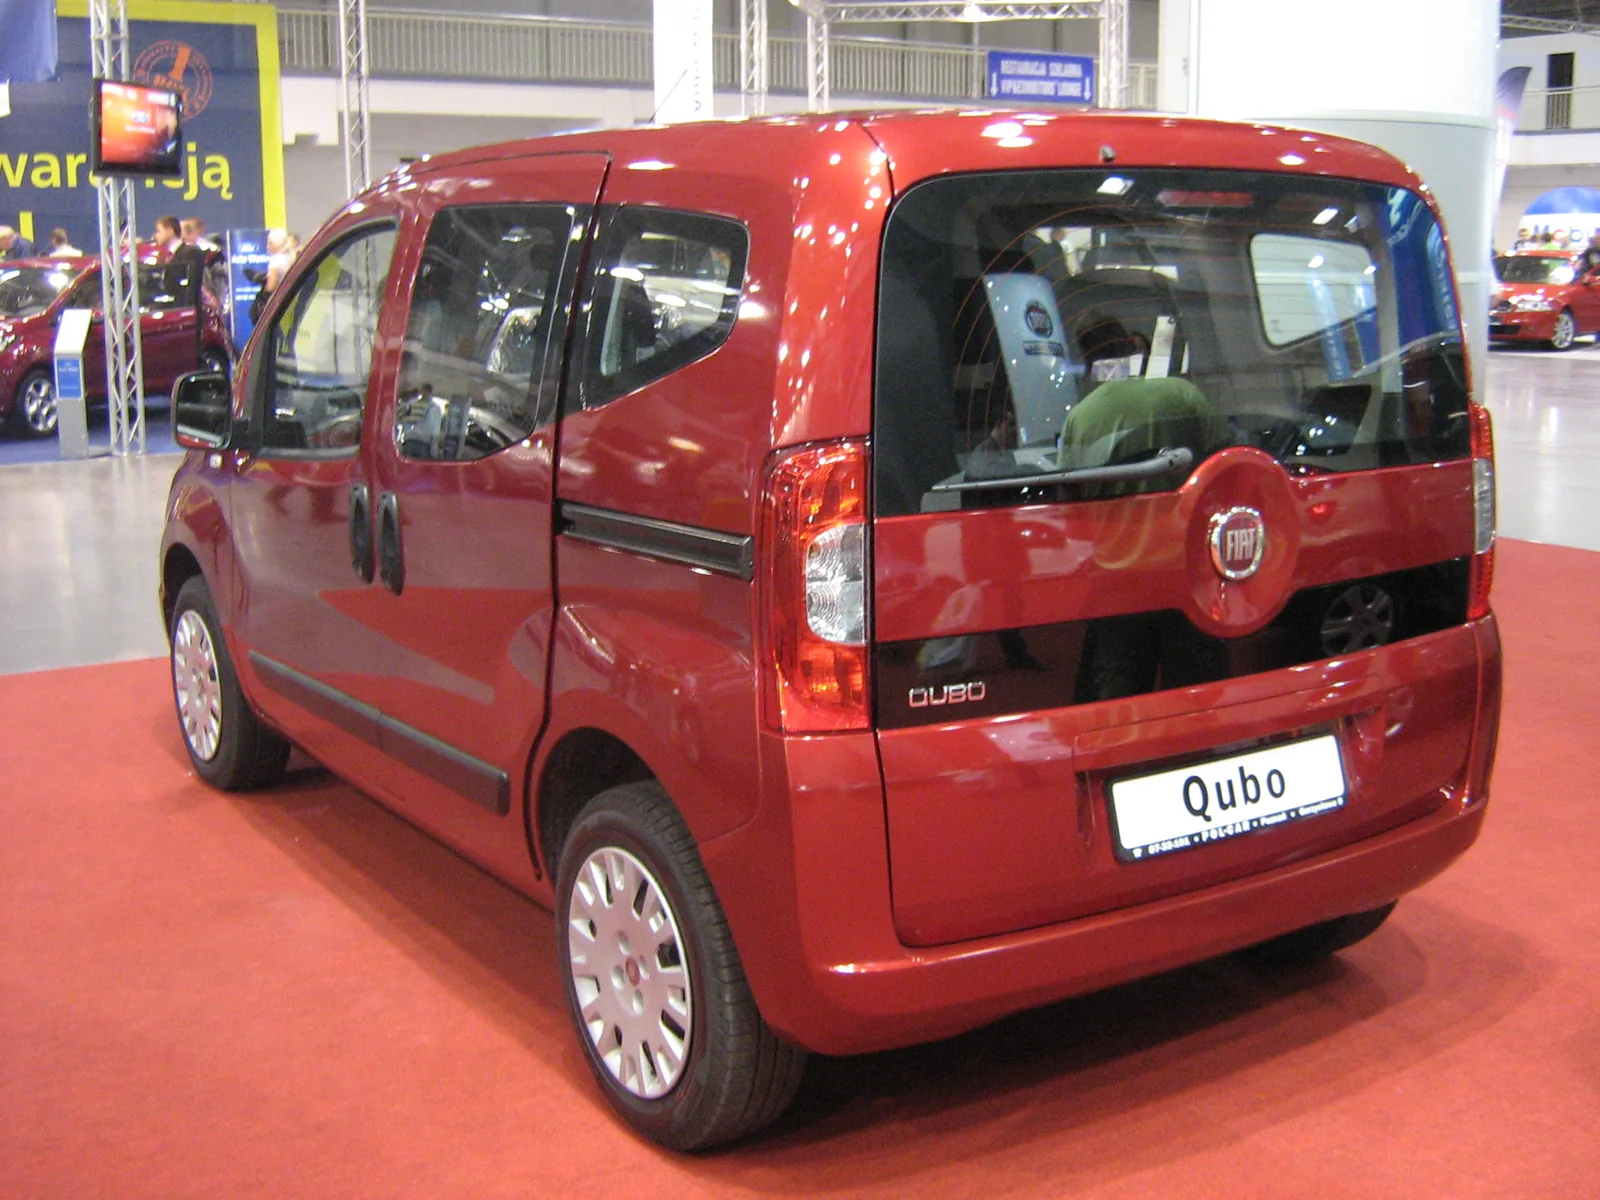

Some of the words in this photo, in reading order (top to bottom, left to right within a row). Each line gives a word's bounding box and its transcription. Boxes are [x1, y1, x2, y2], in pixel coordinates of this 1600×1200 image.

[0, 141, 233, 201] warją
[1226, 527, 1256, 561] FIAT
[908, 681, 986, 708] QUBO
[1182, 765, 1286, 822] Qubo
